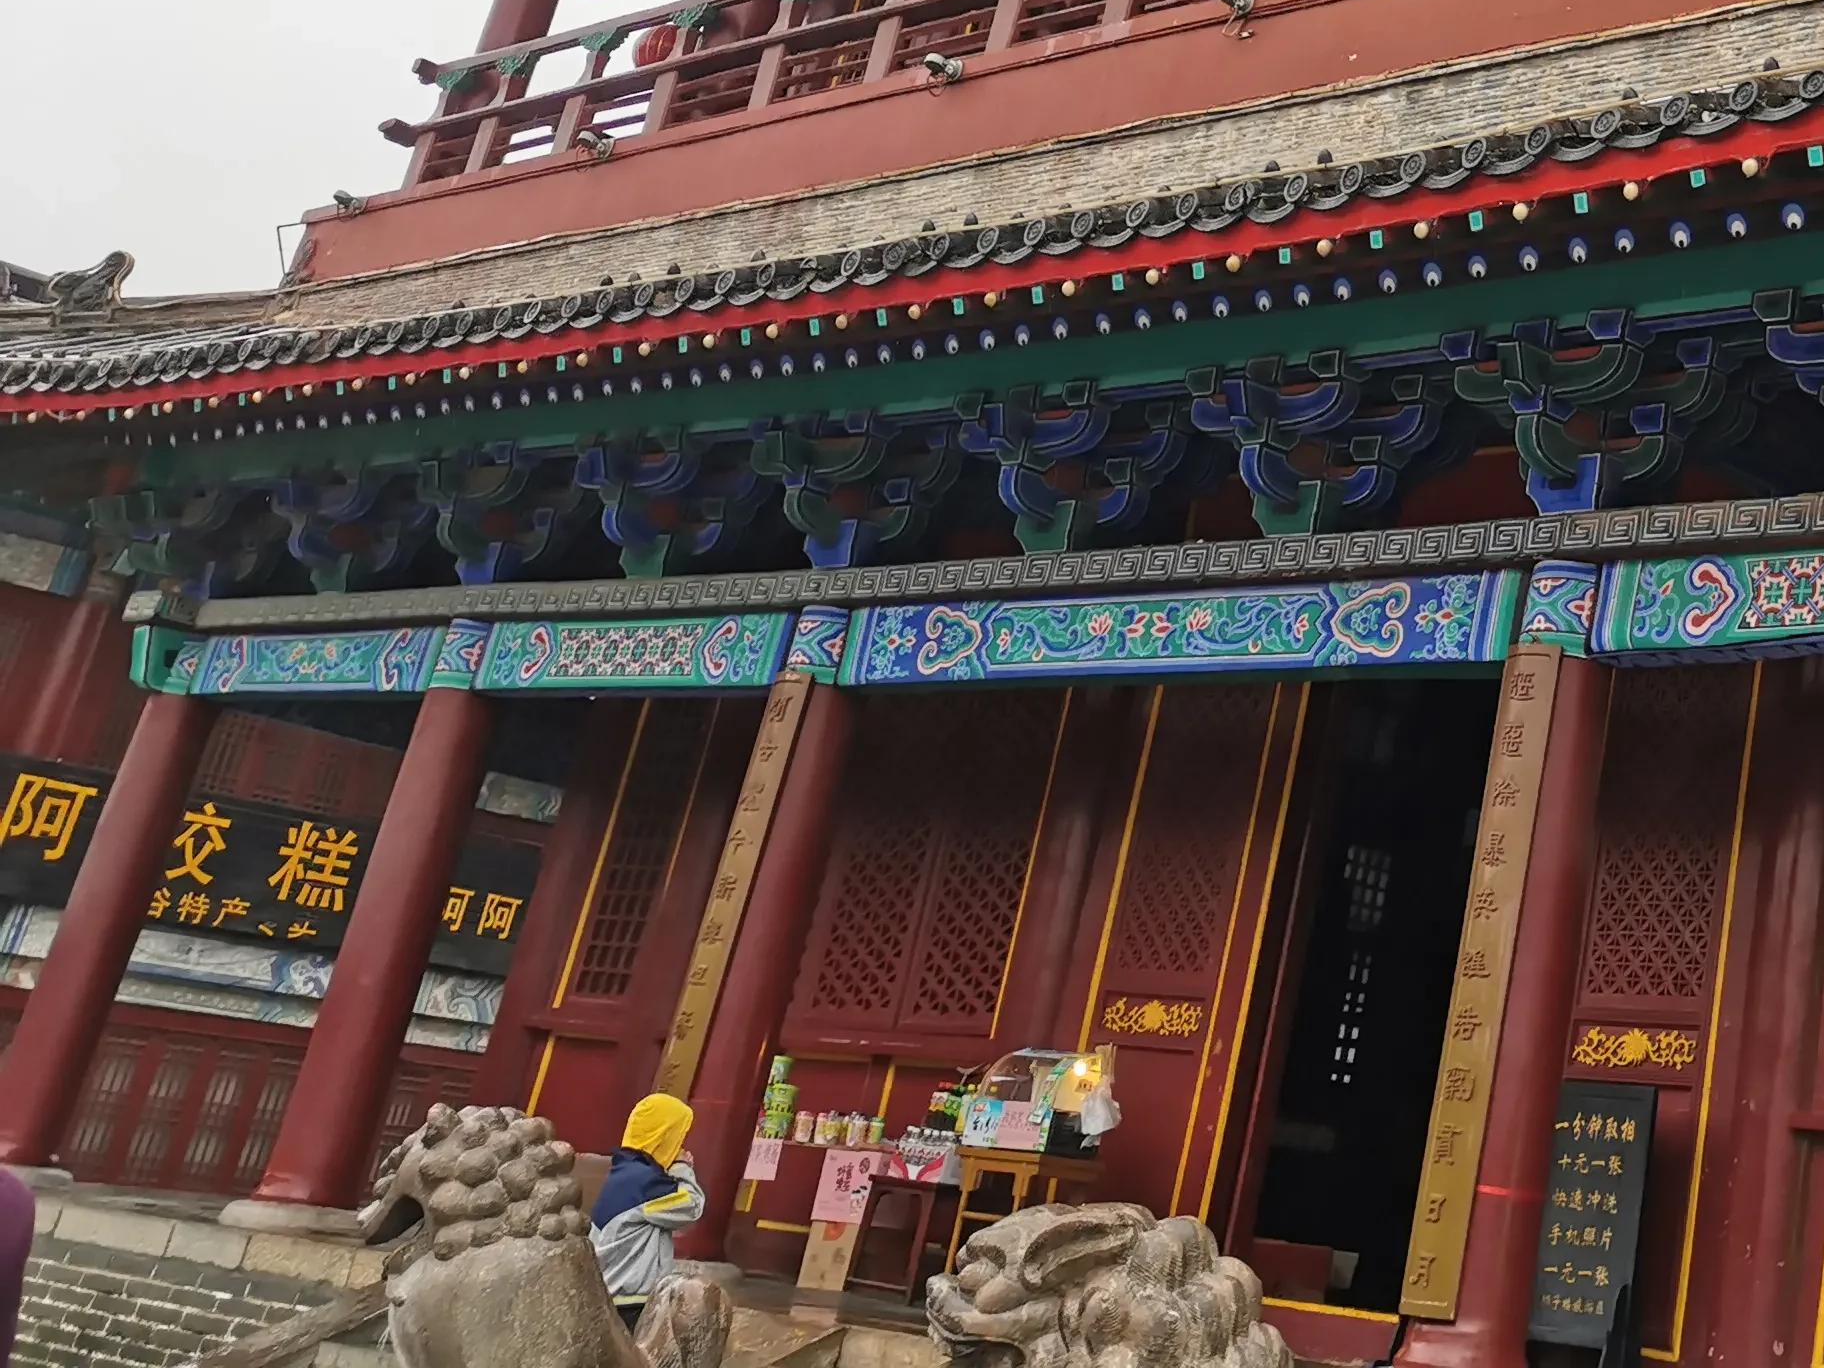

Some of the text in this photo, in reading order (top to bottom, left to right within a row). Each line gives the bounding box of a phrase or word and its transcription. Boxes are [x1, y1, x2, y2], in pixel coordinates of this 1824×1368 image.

[1555, 1111, 1637, 1144] 一分钟取相
[1557, 1152, 1624, 1177] 十元一张
[1551, 1187, 1619, 1215] 快速冲洗
[1548, 1222, 1614, 1252] 手机照片
[1543, 1261, 1610, 1288] 一元一张
